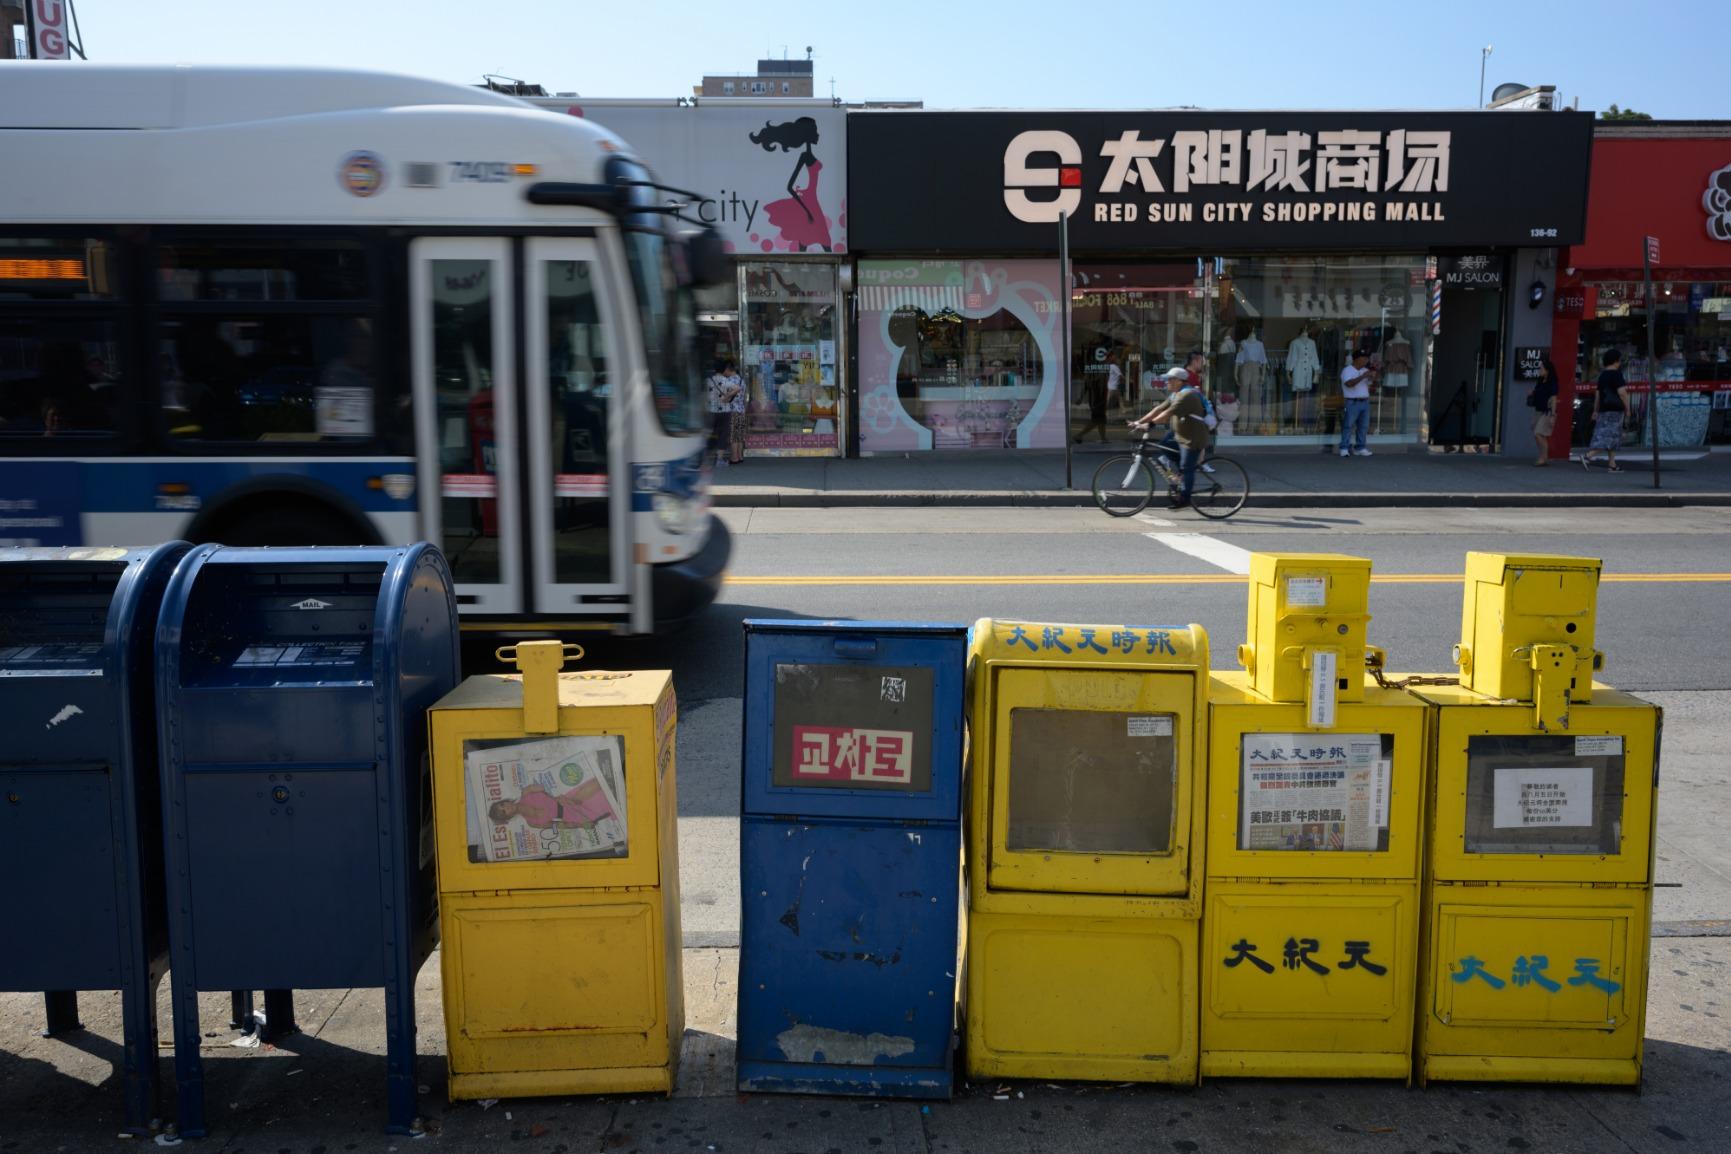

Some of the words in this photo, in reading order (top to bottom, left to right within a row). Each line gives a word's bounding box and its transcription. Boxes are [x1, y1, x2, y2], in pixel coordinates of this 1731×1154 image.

[1098, 128, 1452, 194] 太阳城商场
[698, 189, 759, 233] city
[1094, 202, 1138, 222] RED
[1148, 202, 1193, 222] SUN
[1202, 202, 1253, 222] CITY
[1262, 202, 1376, 221] SHOPPING
[1385, 202, 1446, 221] MALL
[1446, 272, 1463, 283] MJ
[1464, 272, 1500, 283] SALON
[1567, 296, 1584, 307] TESO
[1520, 360, 1543, 369] SALO
[1526, 349, 1541, 360] MJ
[1006, 626, 1177, 656] 大紀元時報
[801, 729, 905, 780] 교차로
[1250, 746, 1347, 761] 大紀元時報
[1223, 937, 1387, 974] 大紀元
[1450, 955, 1622, 993] 大紀元
